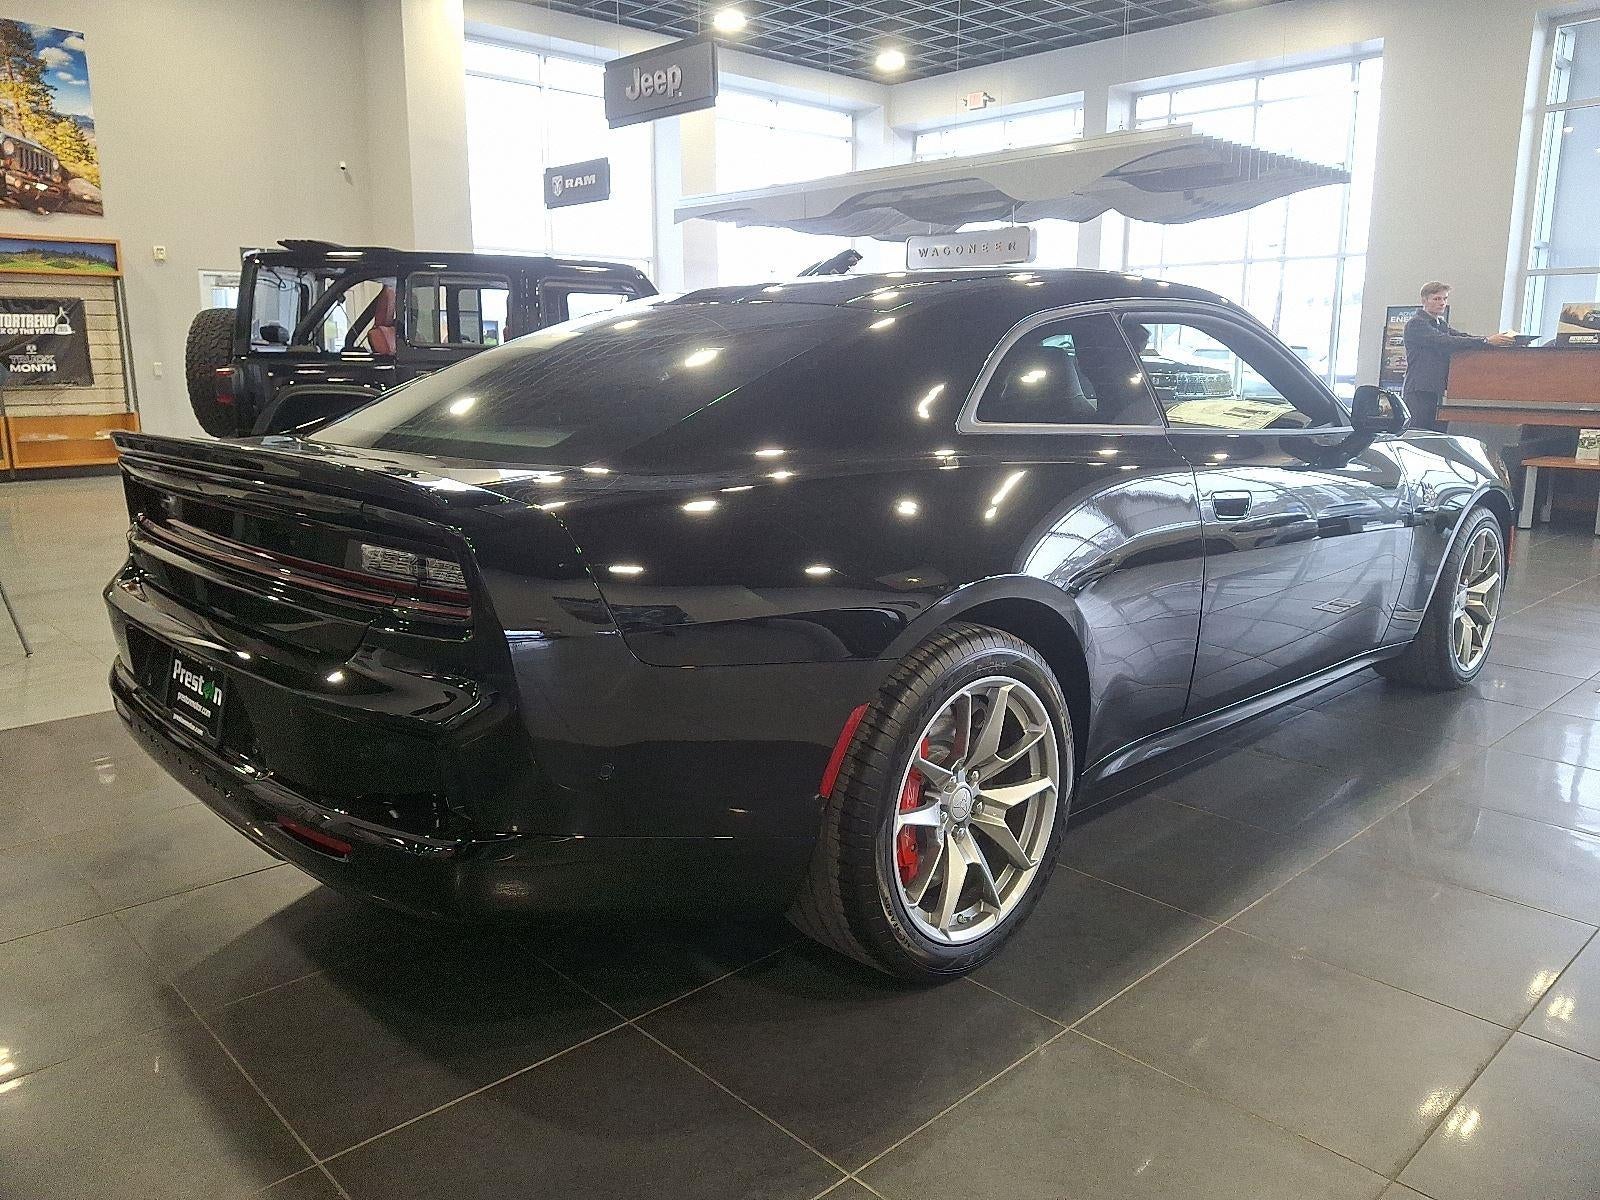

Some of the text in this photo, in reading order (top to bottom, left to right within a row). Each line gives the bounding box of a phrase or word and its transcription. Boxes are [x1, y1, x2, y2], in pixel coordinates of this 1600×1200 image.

[625, 63, 683, 101] Jeep
[564, 174, 596, 189] RAM
[918, 241, 1017, 258] WAGONEER
[9, 363, 57, 372] MONTH
